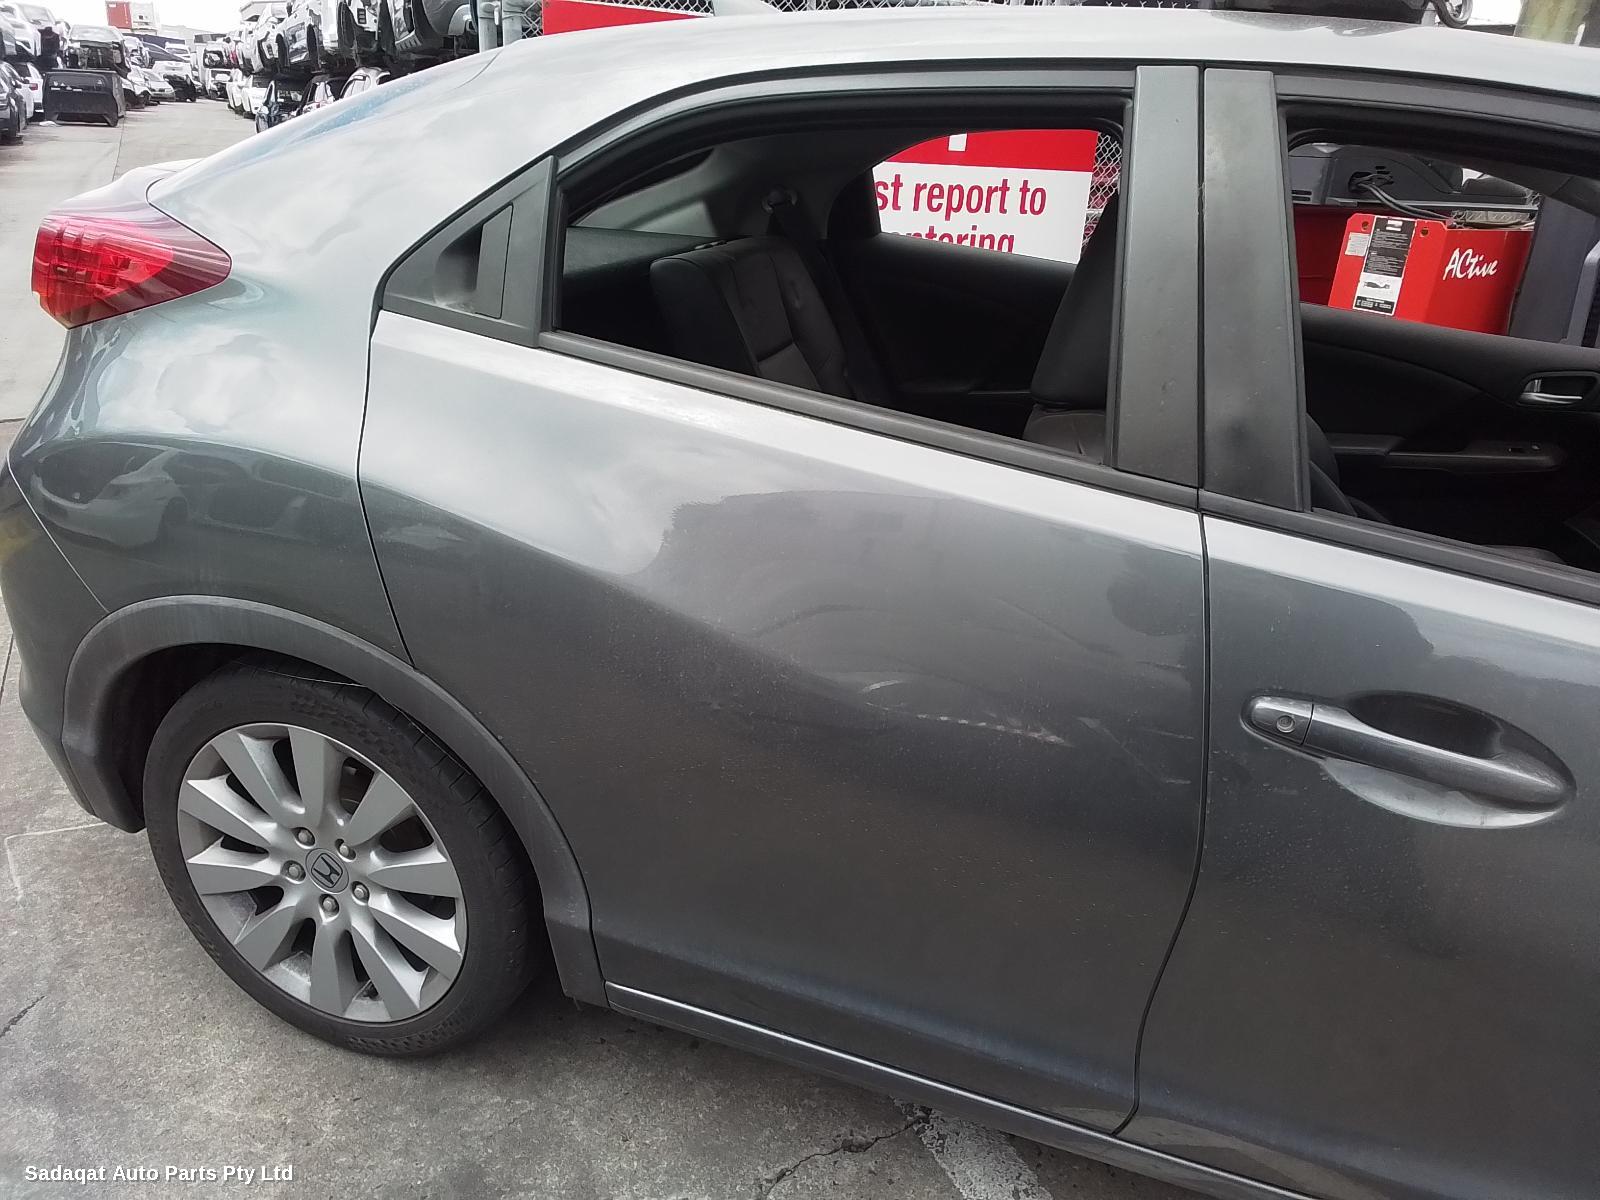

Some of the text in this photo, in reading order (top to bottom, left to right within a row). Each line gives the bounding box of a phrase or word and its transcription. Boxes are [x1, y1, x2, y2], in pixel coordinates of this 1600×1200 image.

[913, 178, 1010, 221] report
[1019, 180, 1046, 215] to
[892, 223, 1015, 254] ring
